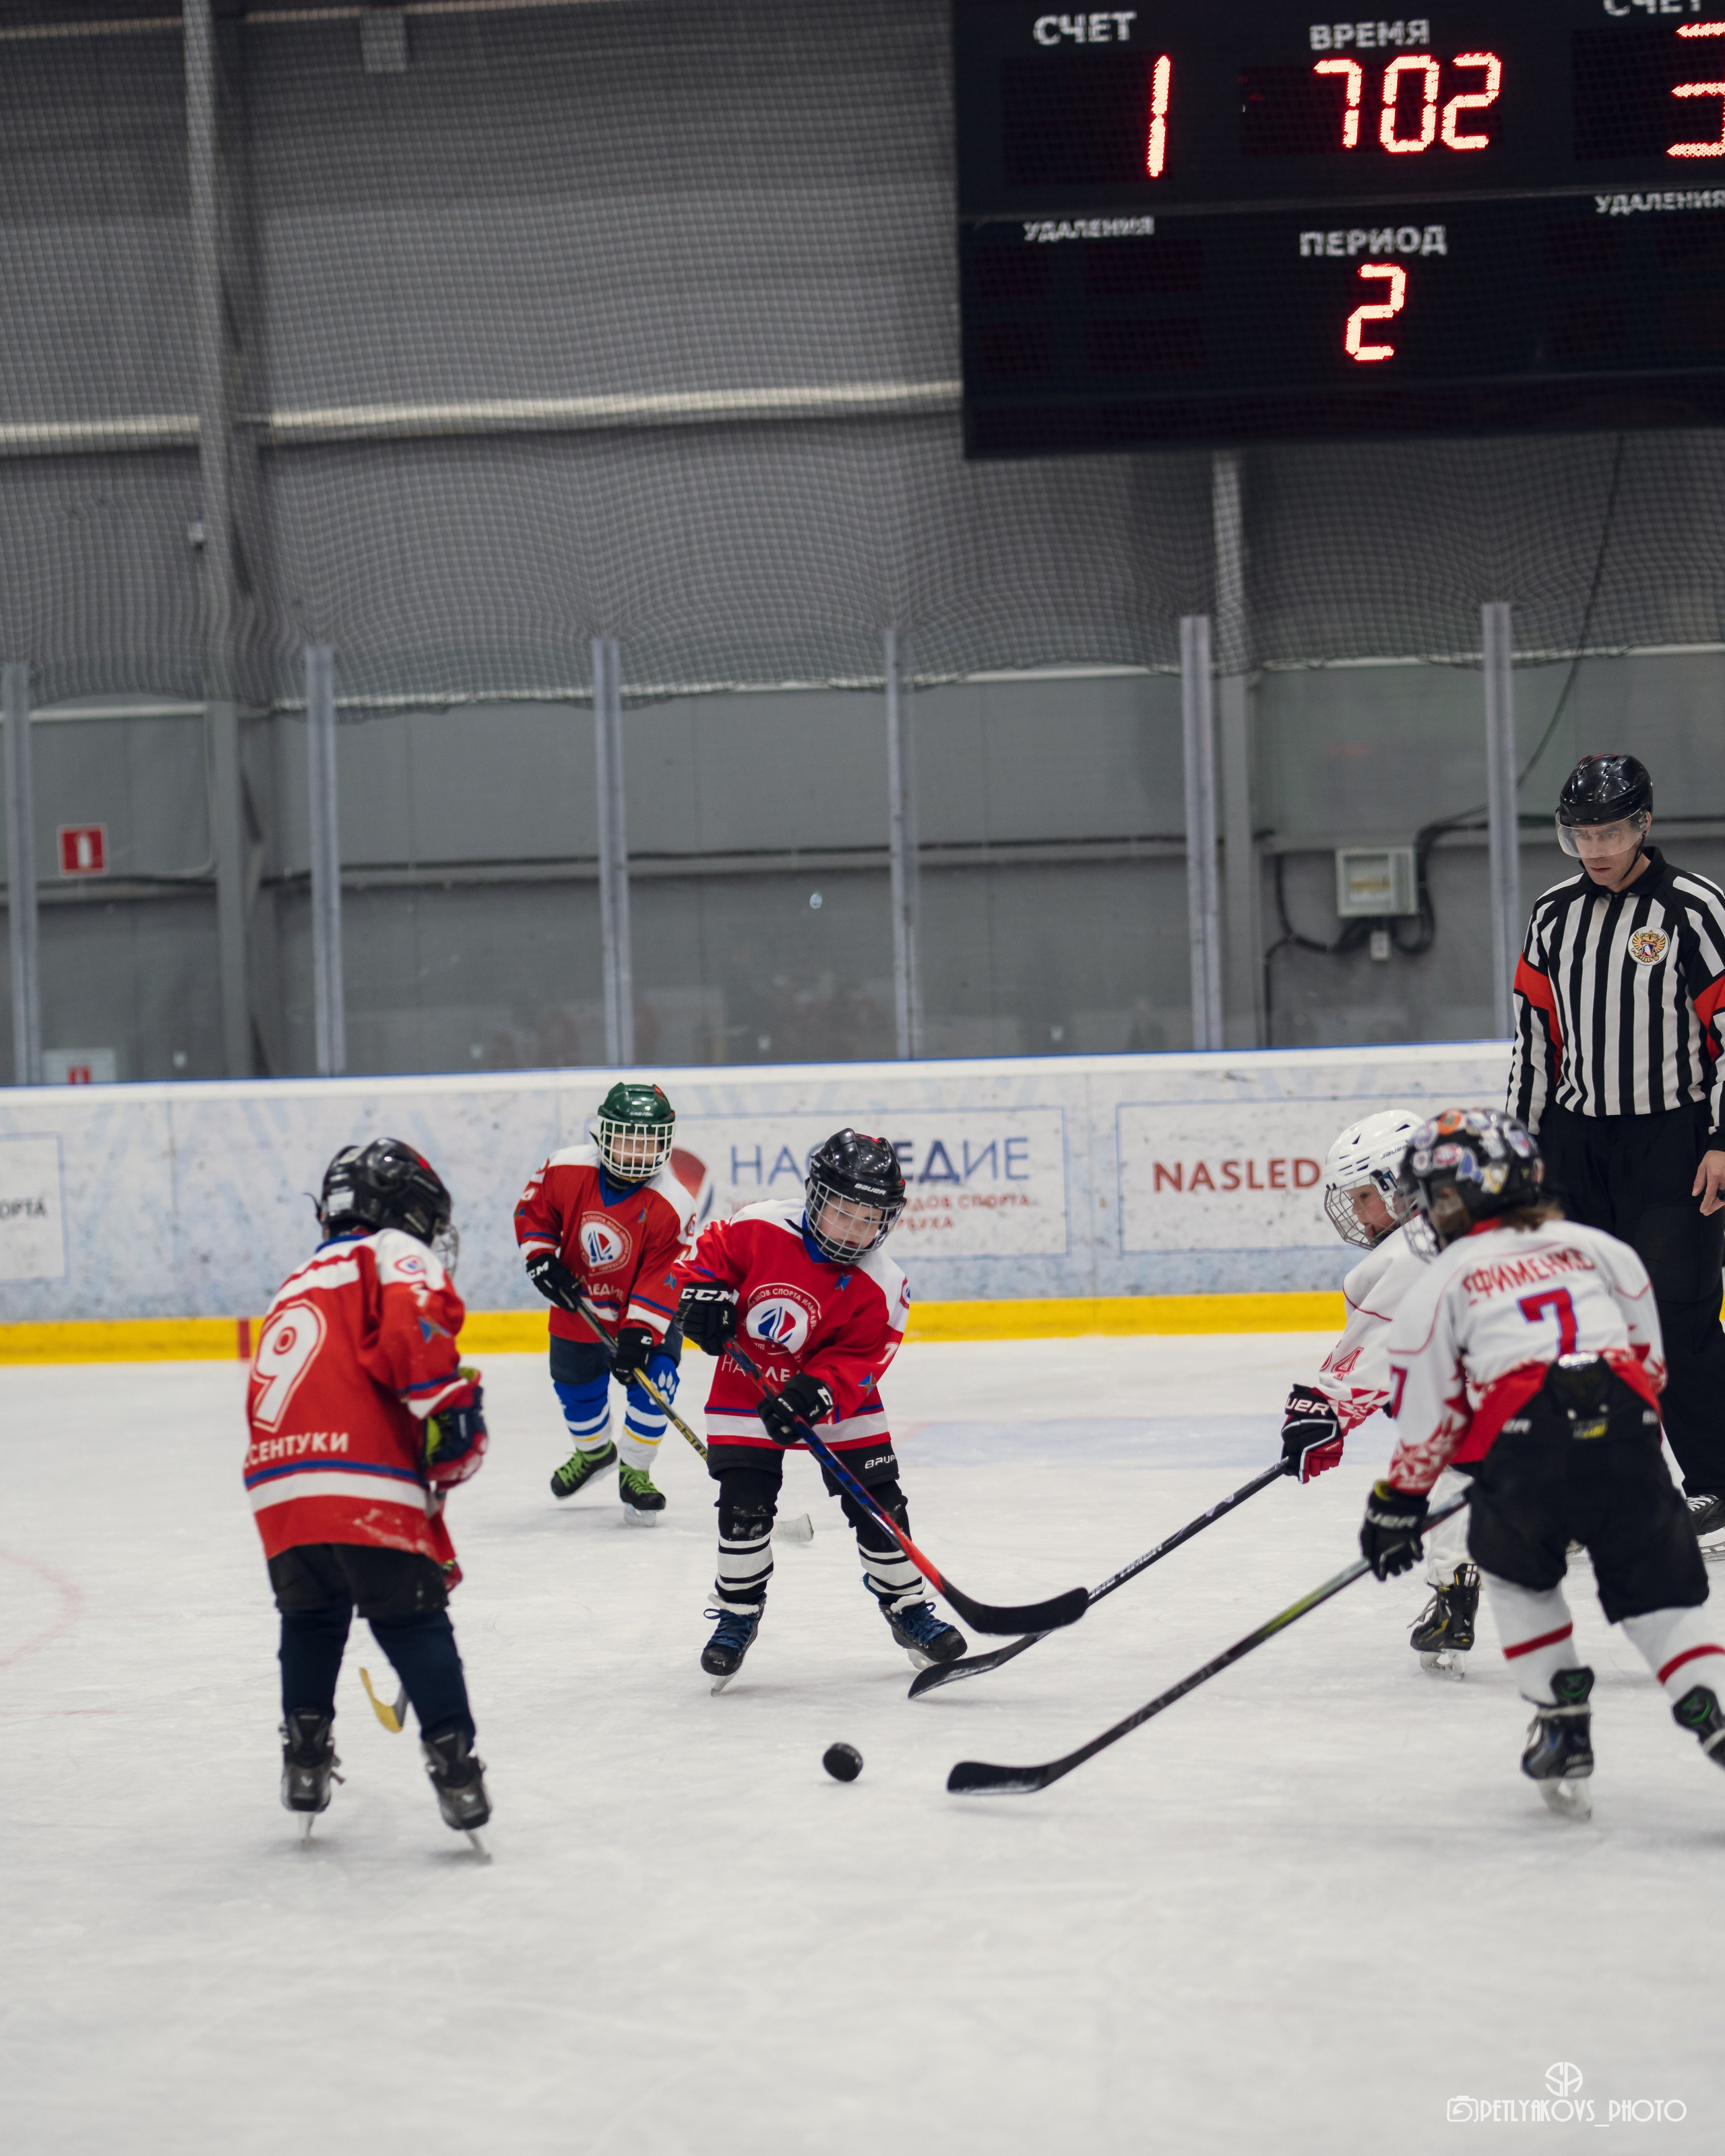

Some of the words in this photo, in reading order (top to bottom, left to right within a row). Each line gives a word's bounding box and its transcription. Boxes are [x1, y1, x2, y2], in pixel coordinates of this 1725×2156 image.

[1033, 11, 1137, 46] СЧЕТ
[1309, 19, 1430, 51] ВРЕМЯ
[1146, 55, 1171, 177] 1
[1023, 216, 1154, 243] УДАЛЕНИЯ
[1300, 225, 1447, 257] ПЕРИОД
[1345, 263, 1406, 362] 2
[854, 1183, 887, 1196] BAUER
[1515, 1286, 1579, 1357] 7
